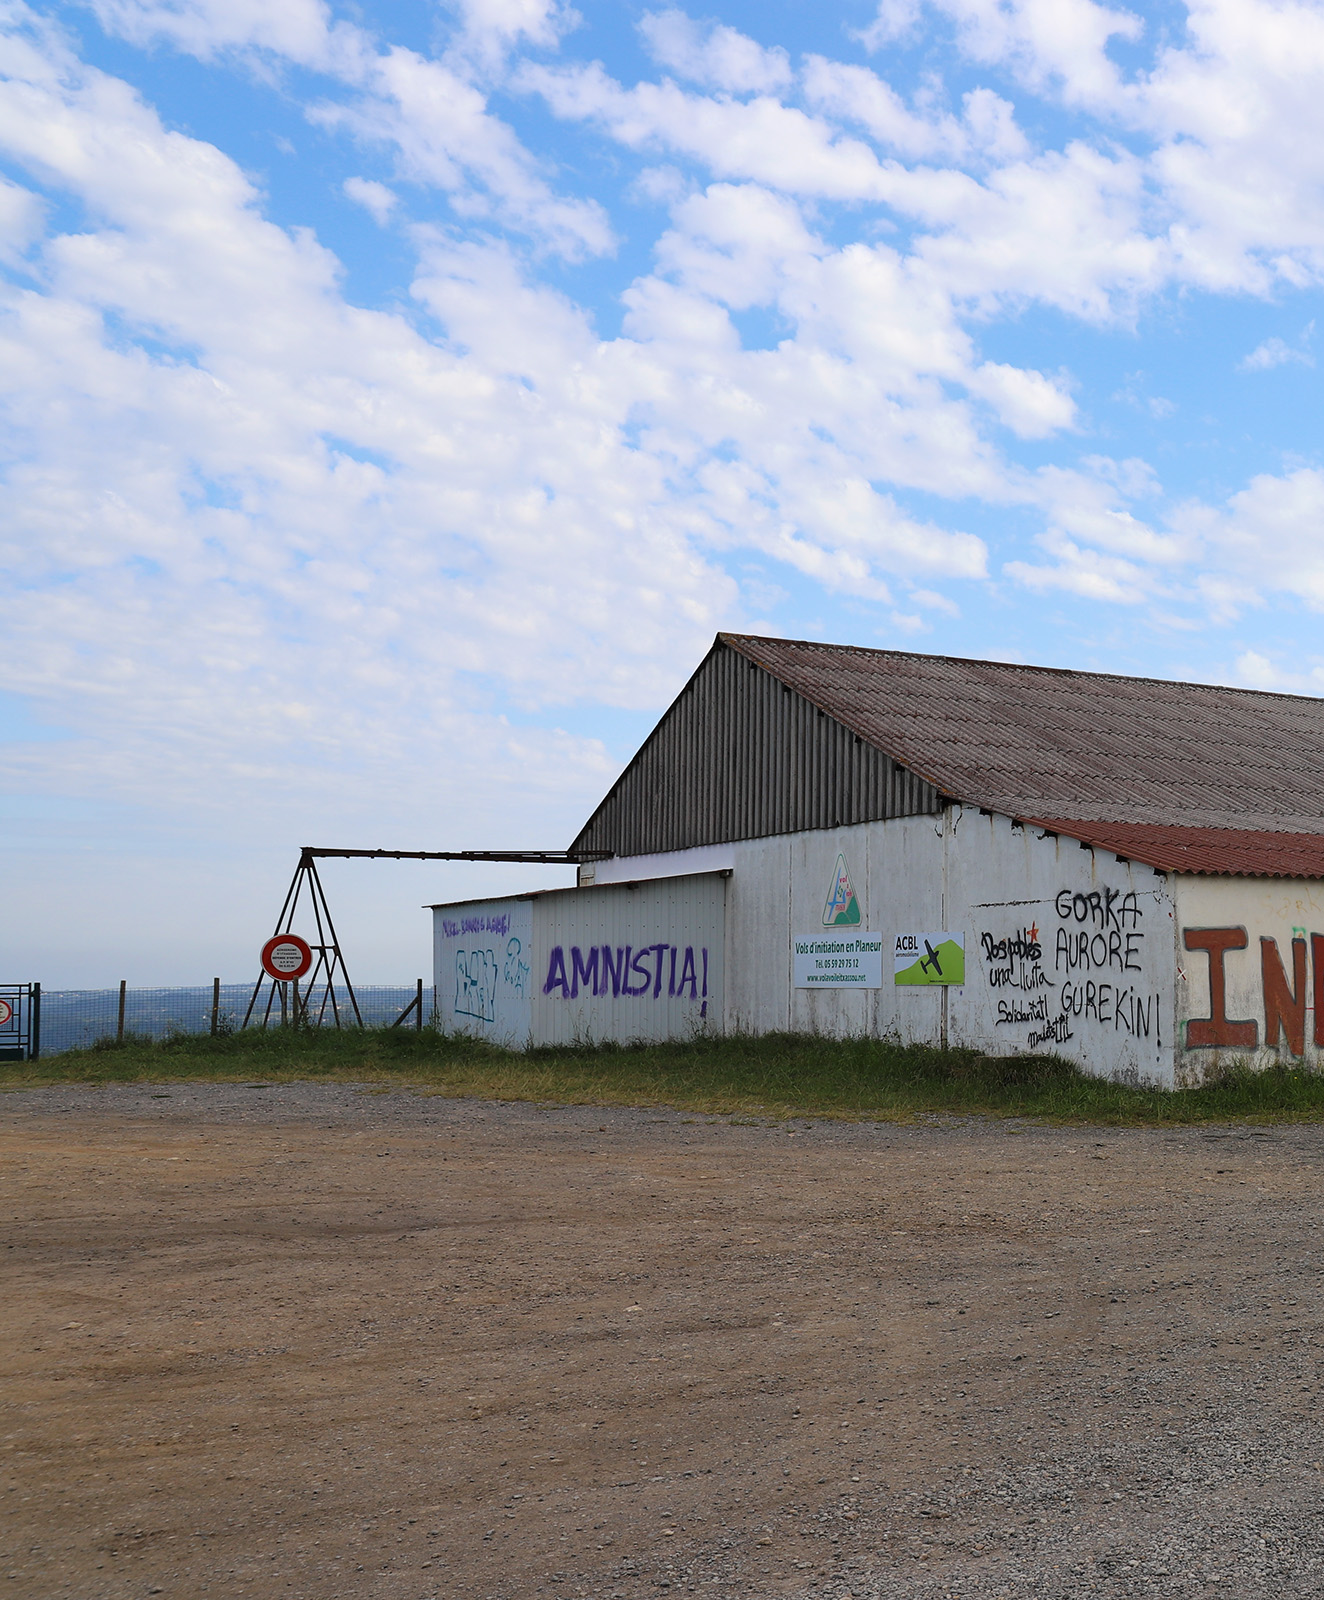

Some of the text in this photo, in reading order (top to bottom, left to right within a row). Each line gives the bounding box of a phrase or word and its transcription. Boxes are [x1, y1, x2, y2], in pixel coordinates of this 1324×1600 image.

[1055, 887, 1143, 933] GORKA
[795, 940, 881, 954] Vols d'initiation en Planeur
[895, 935, 918, 951] ACBL
[1056, 927, 1144, 974] AURORE
[824, 959, 831, 968] 05
[853, 958, 859, 968] 12
[542, 943, 709, 1018] AMNISTIA!
[990, 968, 1019, 988] una
